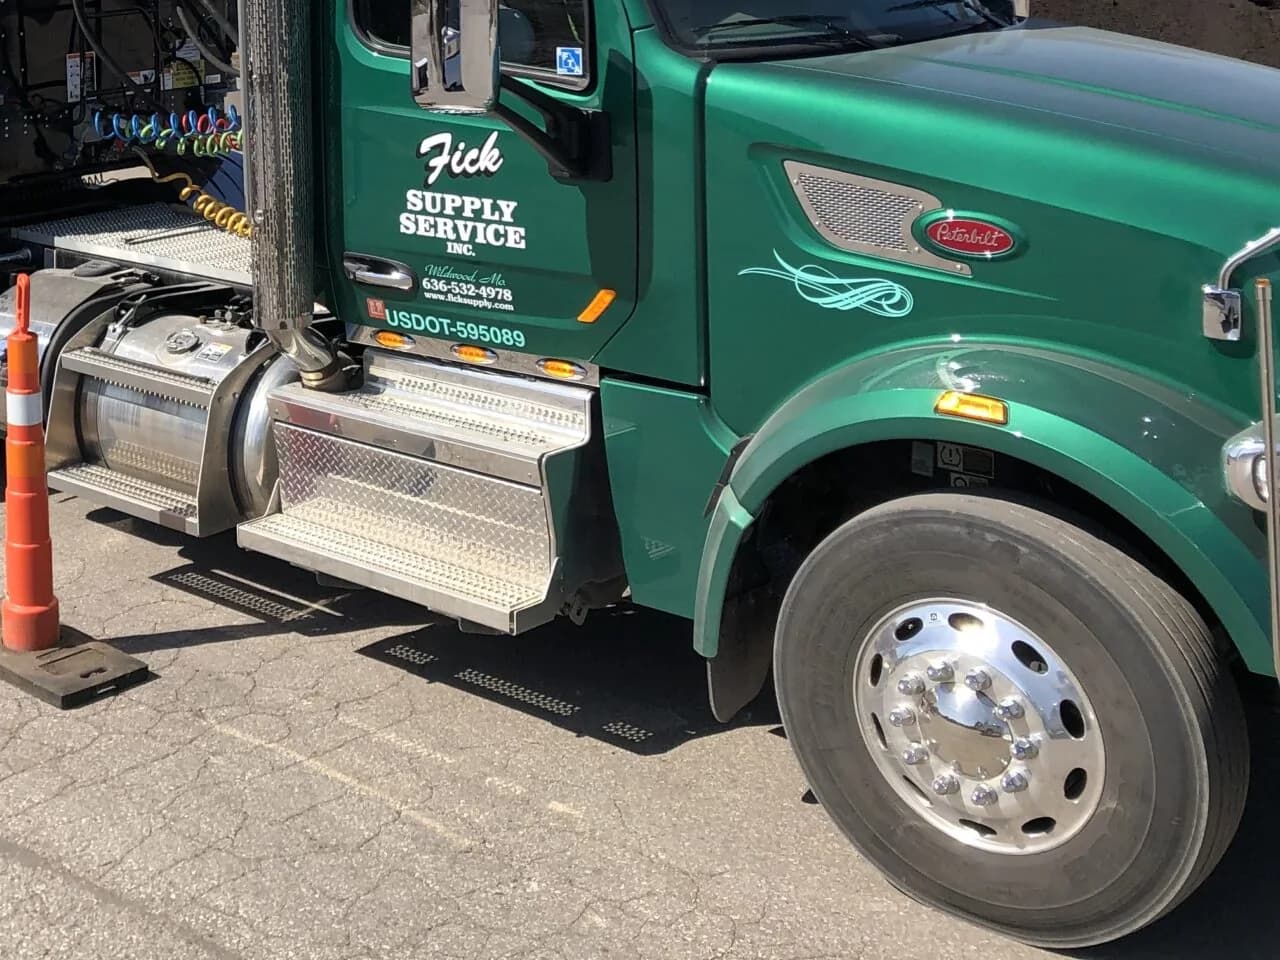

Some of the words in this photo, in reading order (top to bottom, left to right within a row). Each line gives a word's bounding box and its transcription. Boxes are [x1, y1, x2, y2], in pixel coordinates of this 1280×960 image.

[419, 131, 504, 186] Fick
[406, 189, 518, 223] SUPPLY
[399, 212, 526, 249] SERVICE
[937, 223, 1004, 246] Peterbilt
[446, 241, 476, 257] INC.
[422, 277, 513, 302] 636-532-4978
[424, 292, 515, 311] www.ficksupply.com
[385, 308, 526, 348] USDOT-595089
